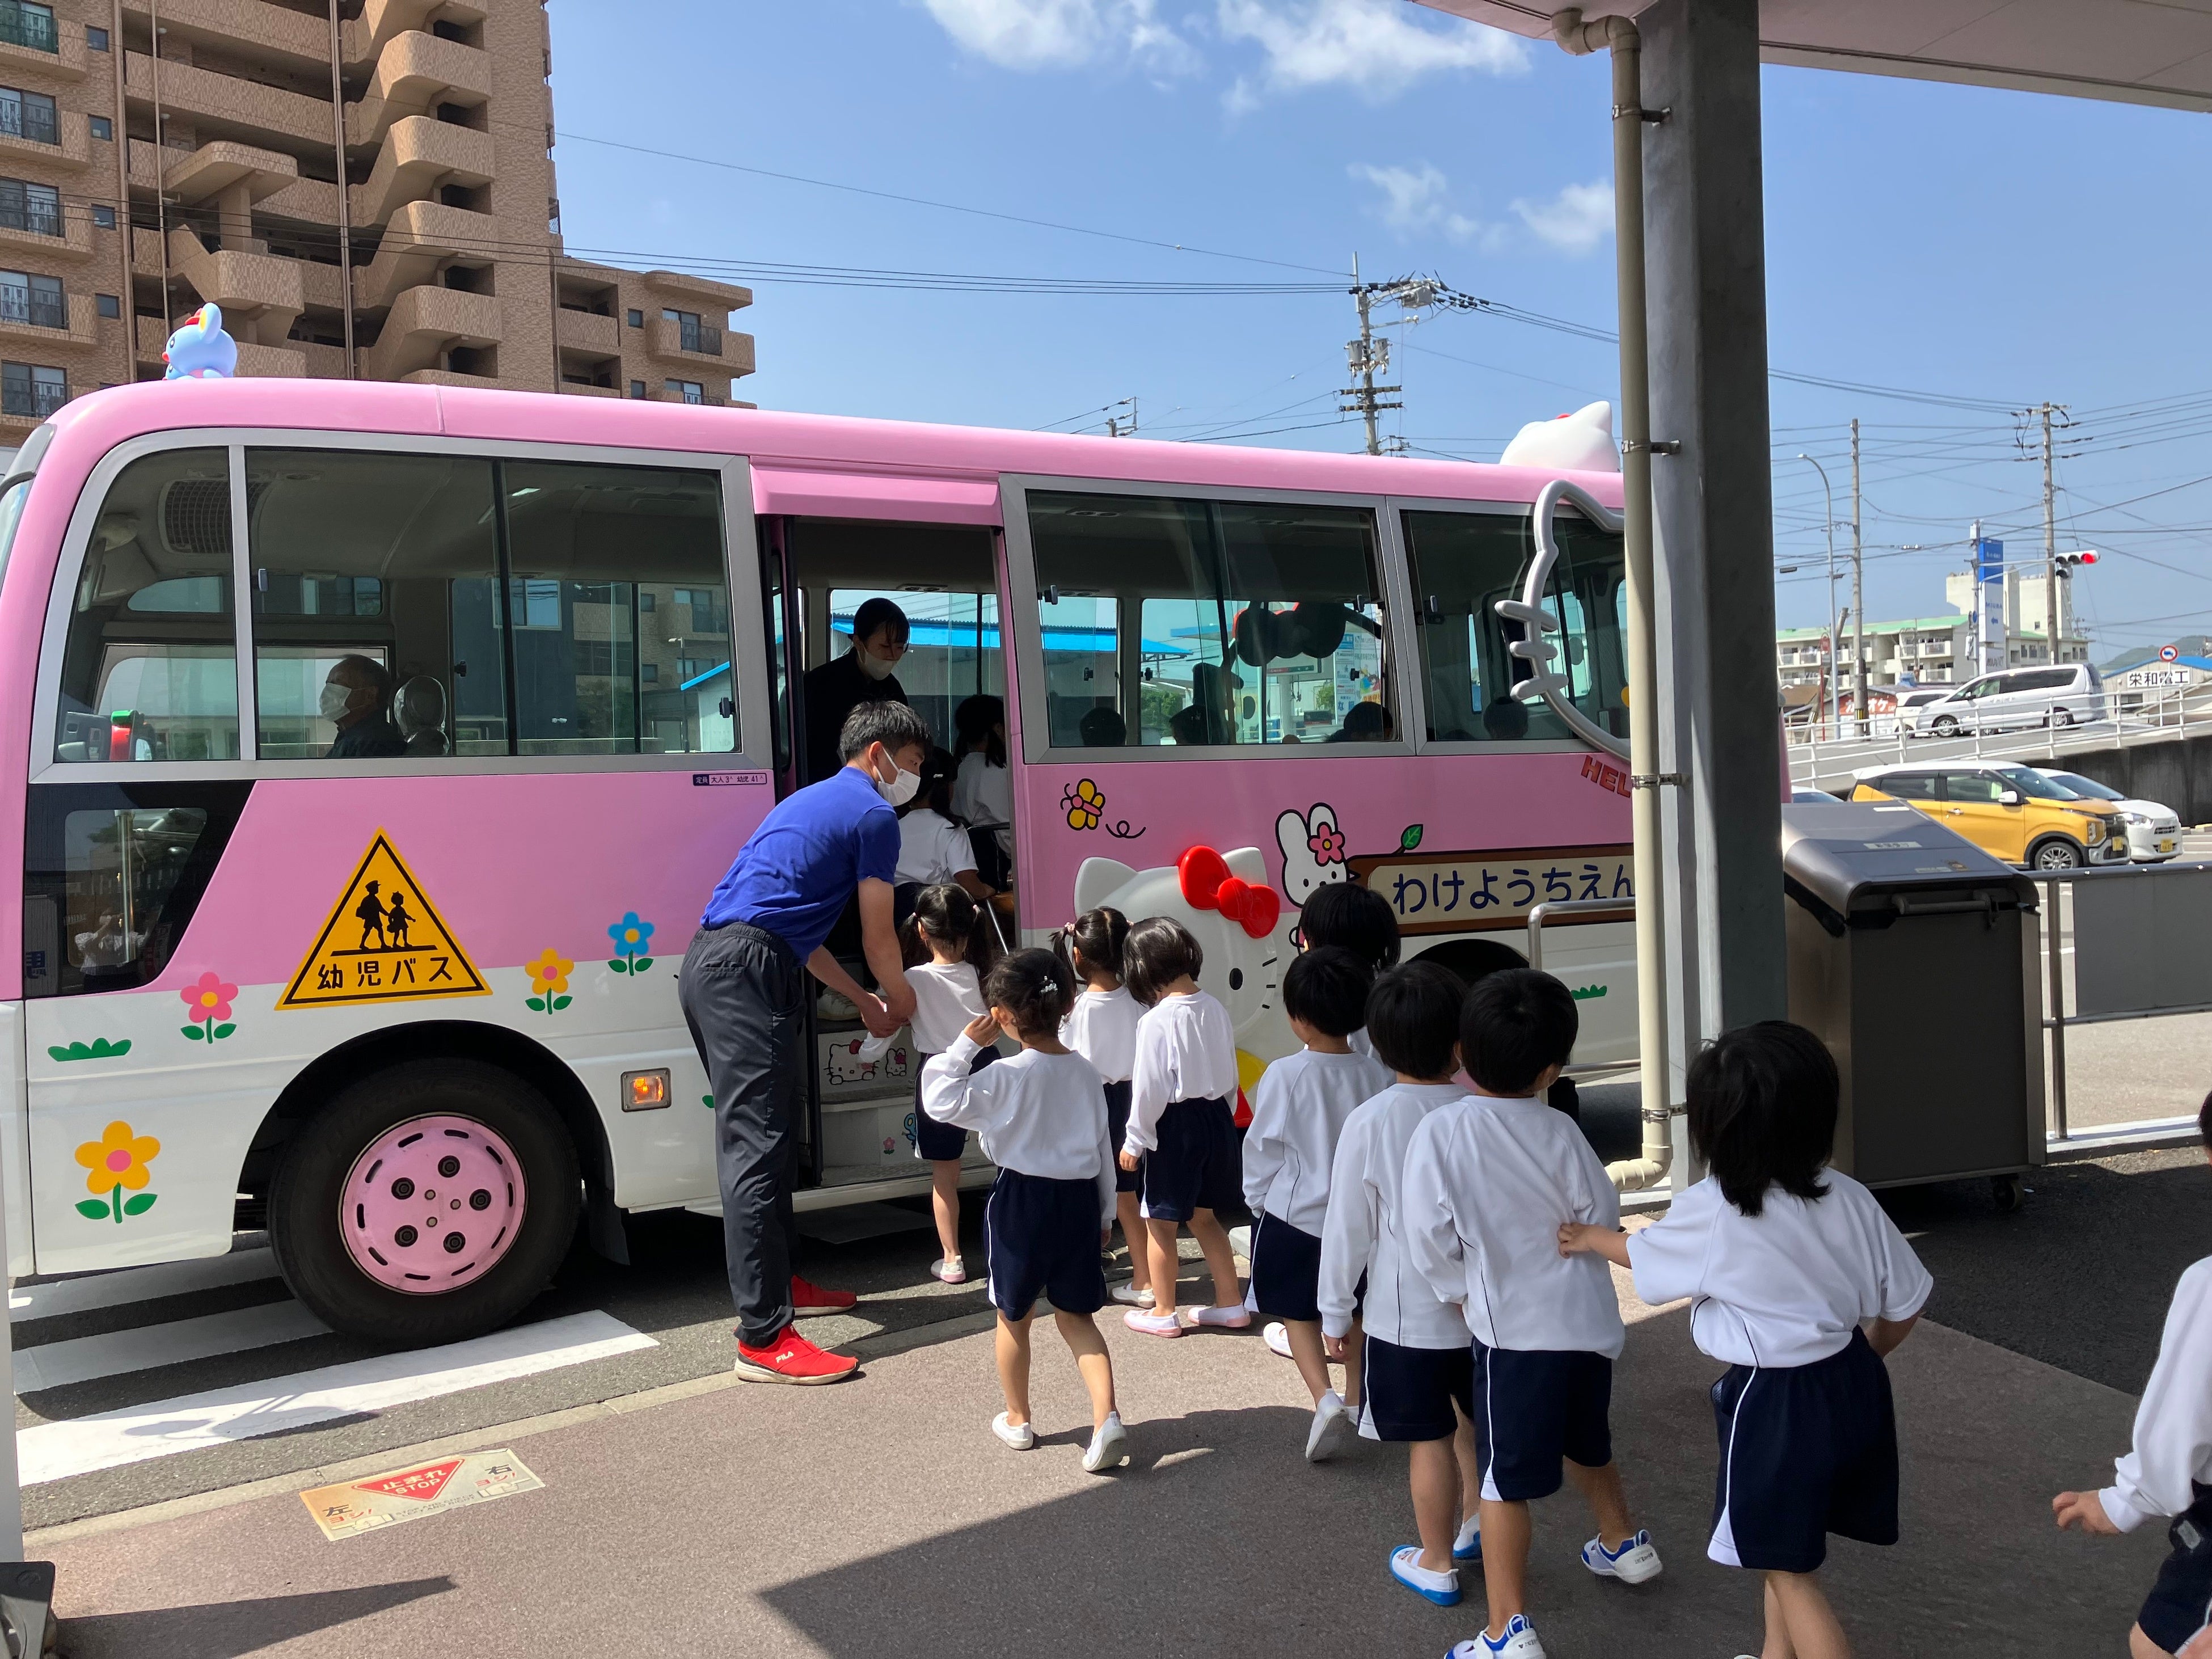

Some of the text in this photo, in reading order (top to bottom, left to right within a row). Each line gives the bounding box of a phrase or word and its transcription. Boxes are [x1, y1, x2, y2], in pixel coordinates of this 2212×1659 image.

[2129, 670, 2188, 687] 栄和電工
[1845, 698, 1888, 713] カオケ
[1392, 863, 1635, 915] わけようちえん
[317, 956, 453, 990] 幼児バス
[775, 1350, 794, 1363] FILA
[485, 1464, 513, 1475] 右
[382, 1469, 448, 1491] 止まれ
[395, 1478, 441, 1495] STOP
[322, 1504, 353, 1517] 左
